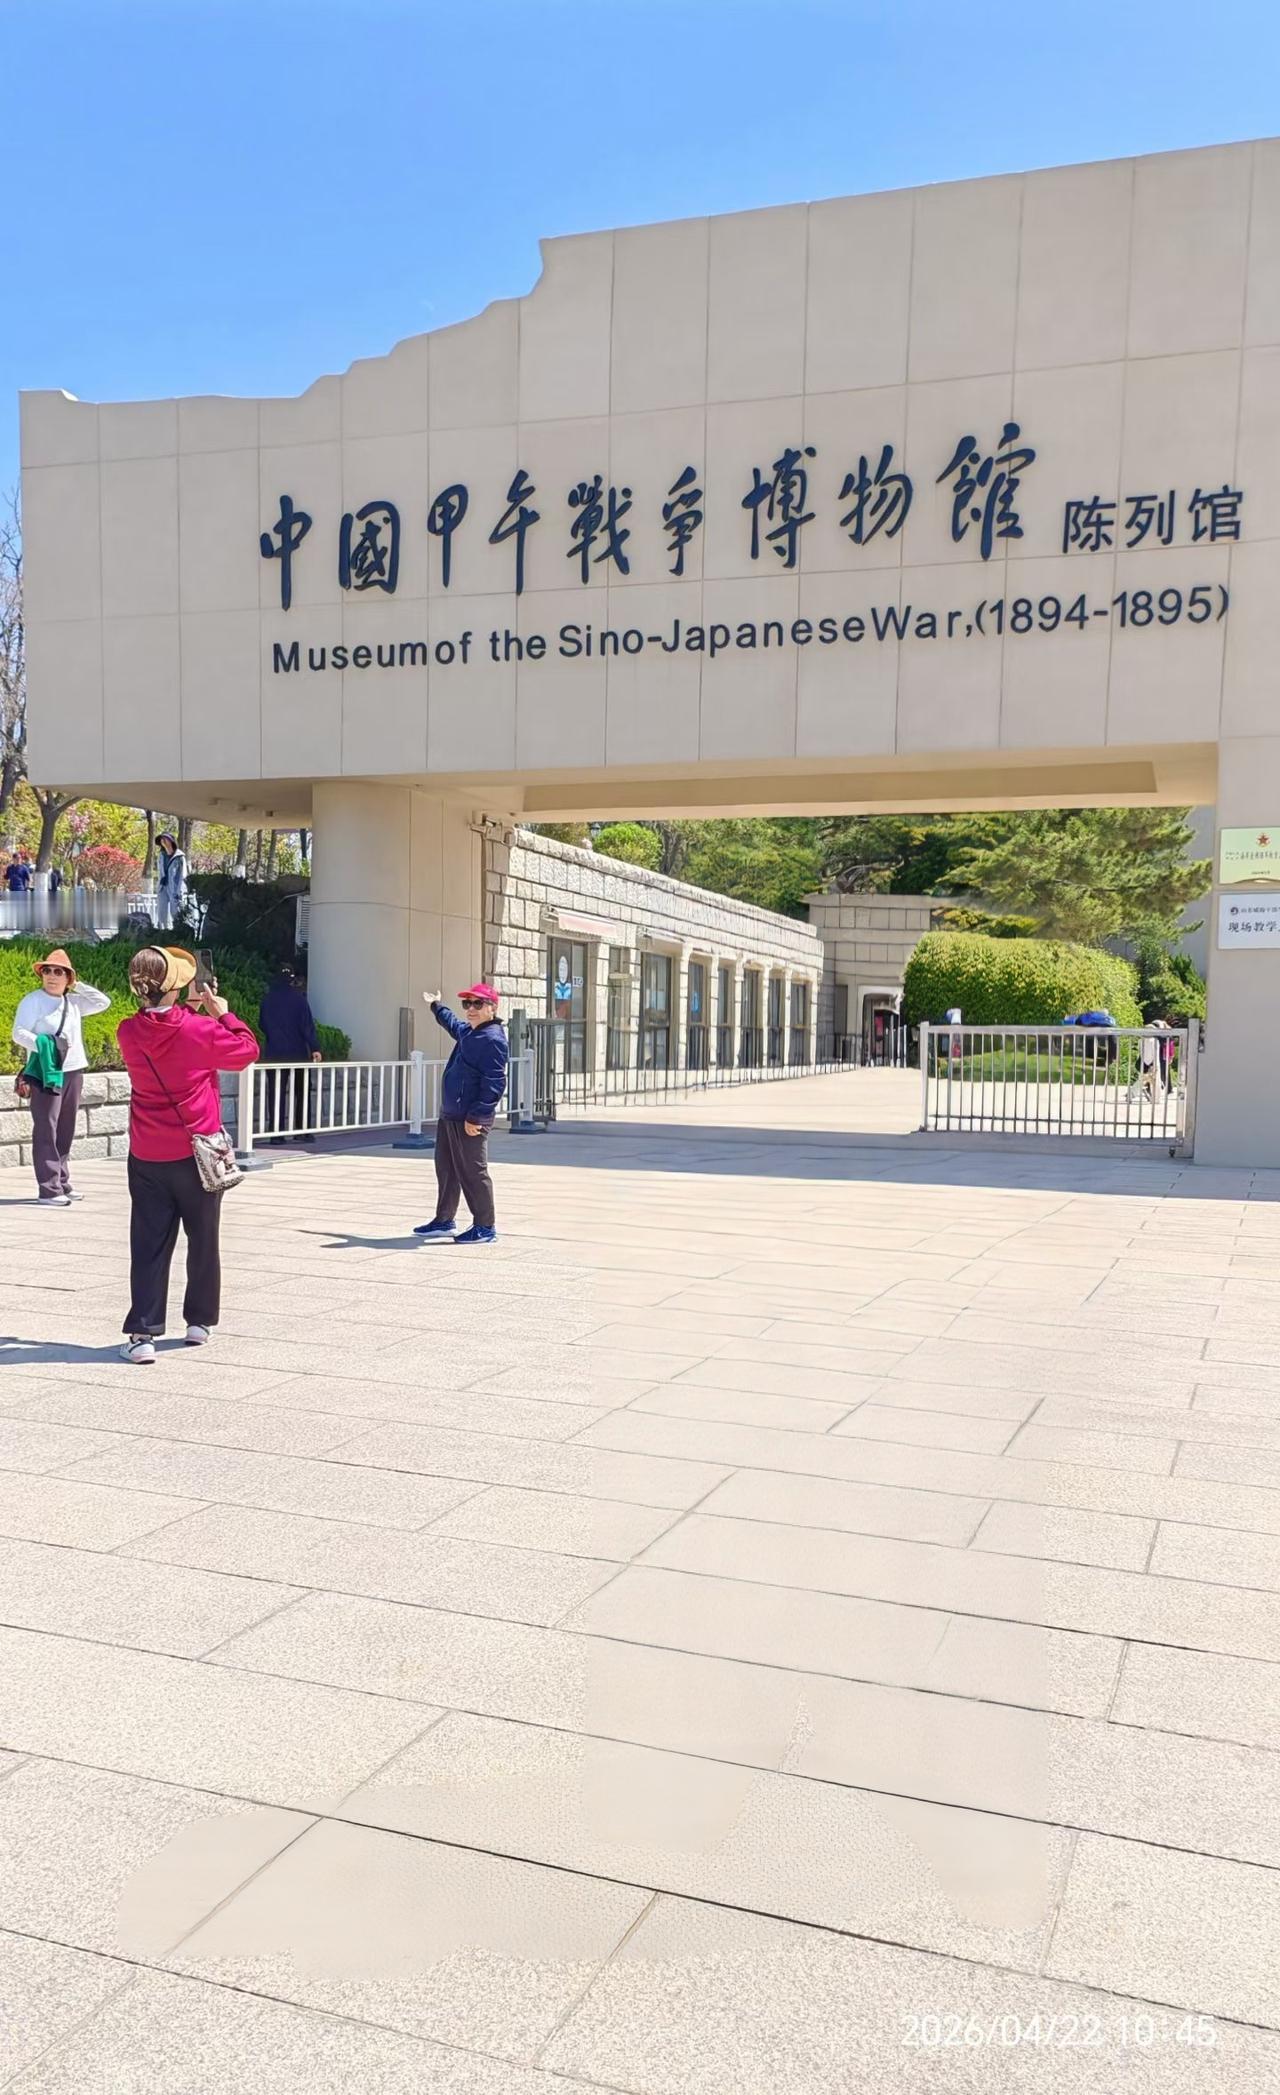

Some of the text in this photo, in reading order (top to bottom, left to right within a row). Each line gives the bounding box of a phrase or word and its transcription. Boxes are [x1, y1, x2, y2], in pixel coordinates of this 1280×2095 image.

[1062, 484, 1244, 555] 陈列馆
[488, 629, 547, 662] the
[1228, 920, 1280, 933] 现场教学
